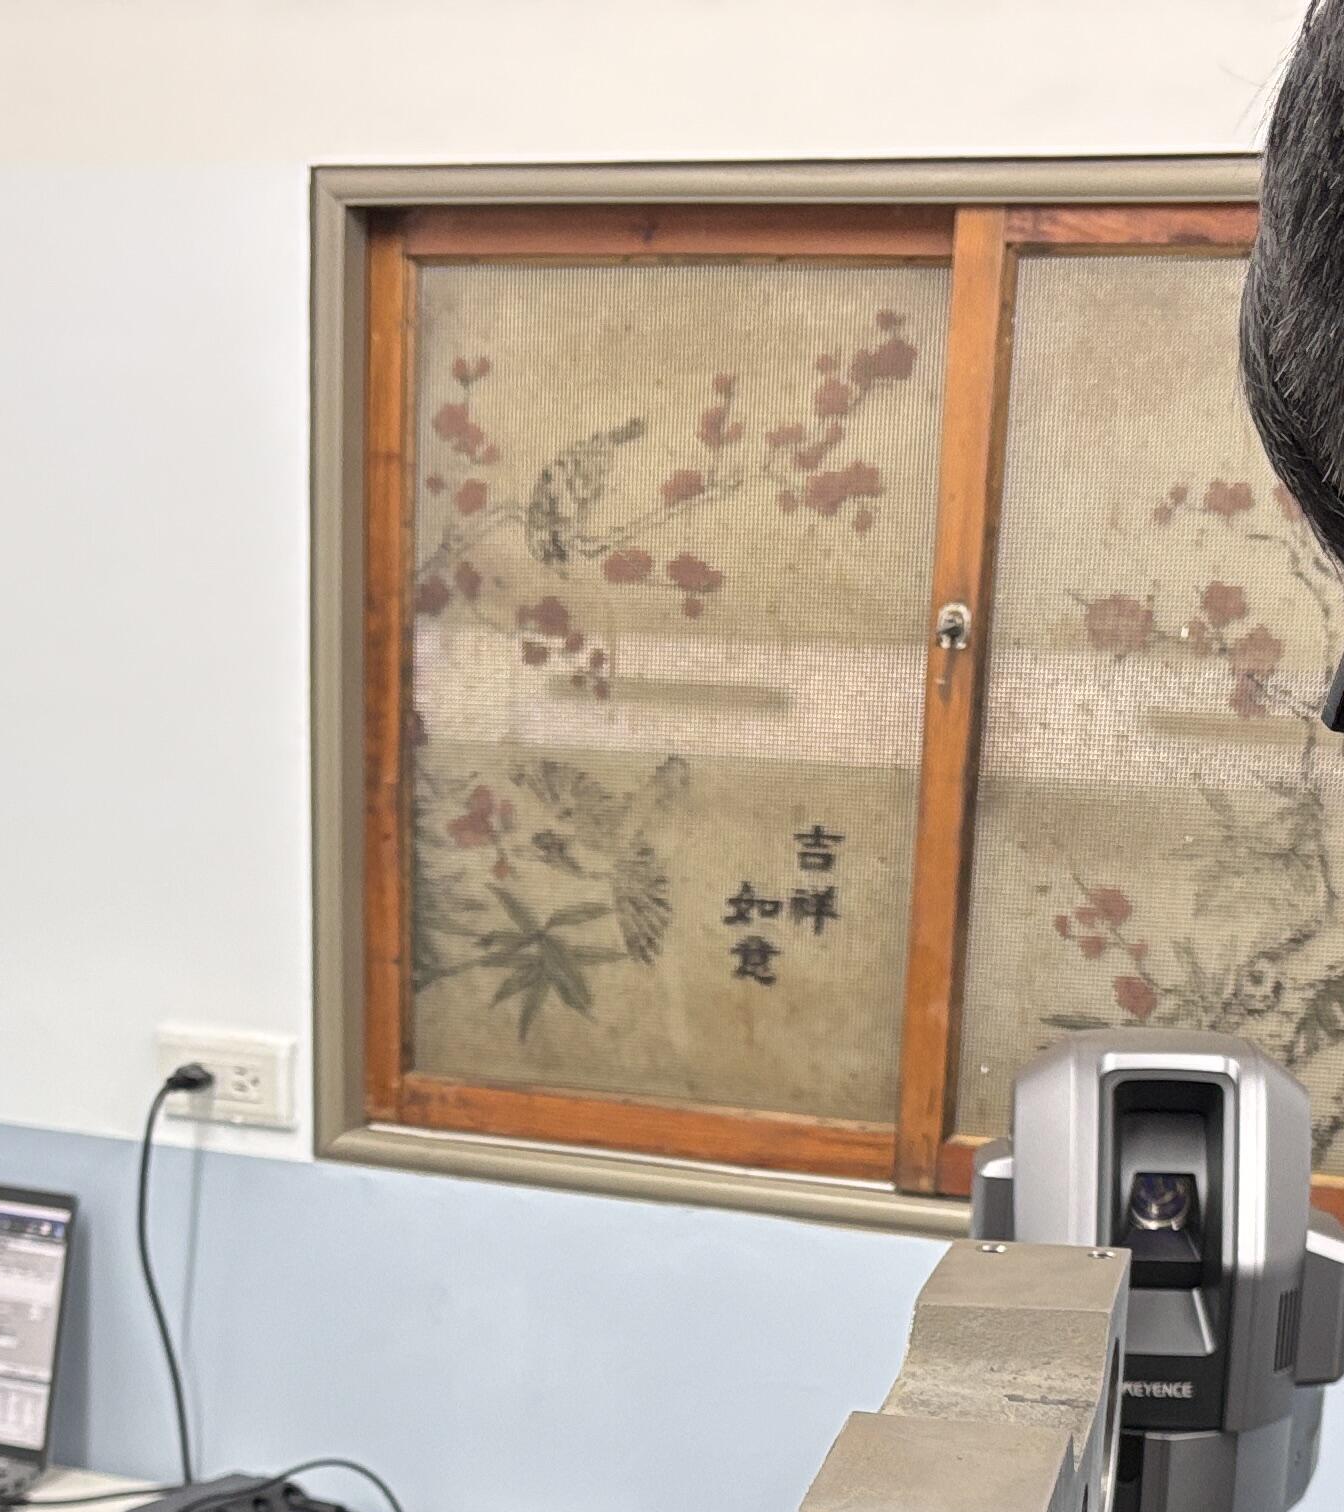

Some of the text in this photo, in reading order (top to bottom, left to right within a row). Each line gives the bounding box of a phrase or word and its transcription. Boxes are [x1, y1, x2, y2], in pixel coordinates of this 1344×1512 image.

[790, 825, 846, 936] 吉祥
[722, 881, 782, 986] 如意
[1121, 1381, 1193, 1399] KEYENCE
